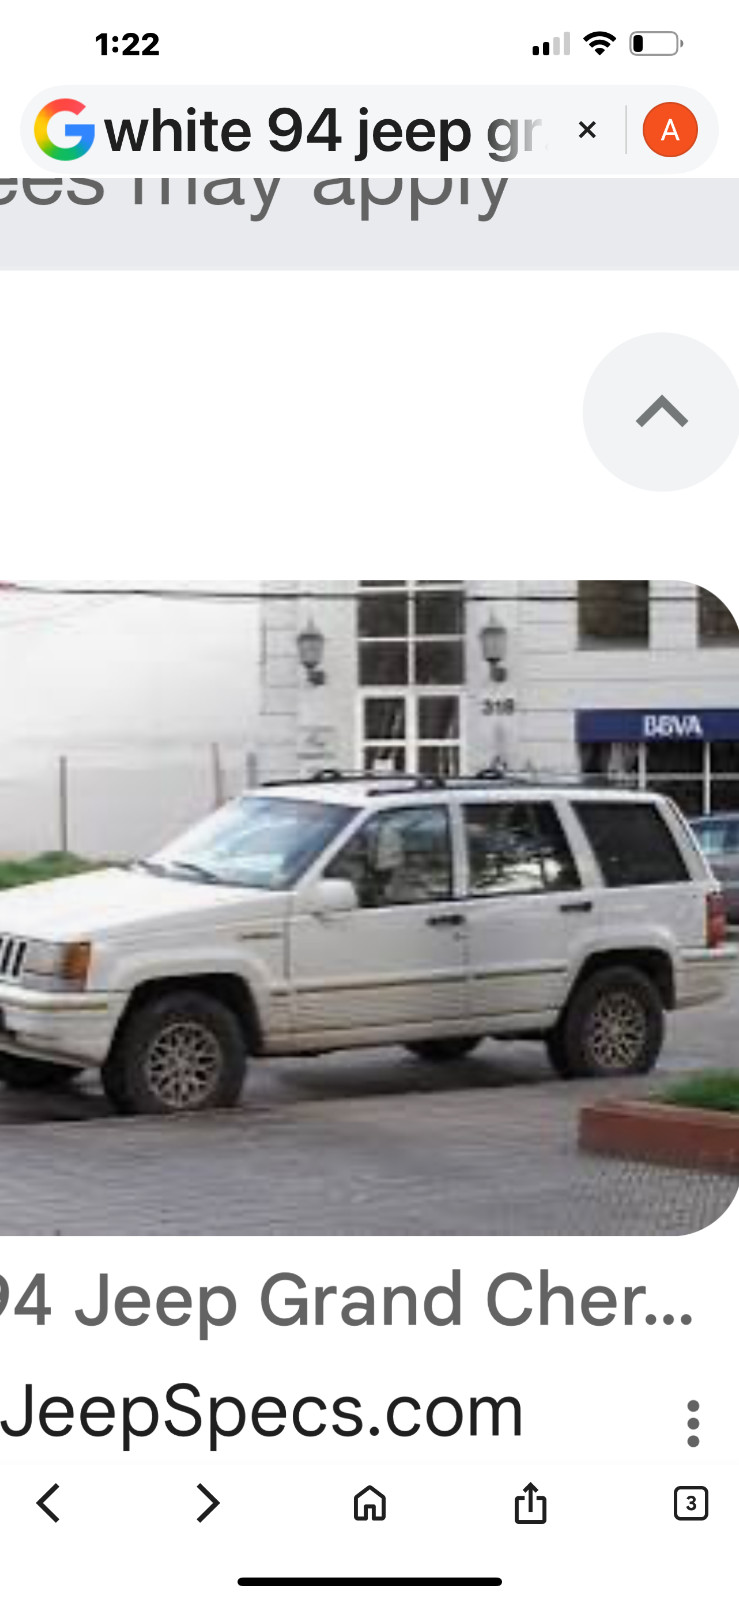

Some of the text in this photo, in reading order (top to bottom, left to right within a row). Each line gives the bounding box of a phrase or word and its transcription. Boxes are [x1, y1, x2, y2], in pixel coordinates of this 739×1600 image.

[95, 32, 160, 56] 1:22
[34, 98, 95, 161] G
[103, 106, 252, 153] white
[267, 106, 343, 153] 94
[354, 106, 472, 163] jeep
[660, 118, 681, 141] A
[643, 714, 703, 737] BBVA
[0, 1268, 693, 1341] 4 Jeep Grand Cher...
[0, 1382, 522, 1452] JeepSpecs.com
[685, 1495, 697, 1511] 3
